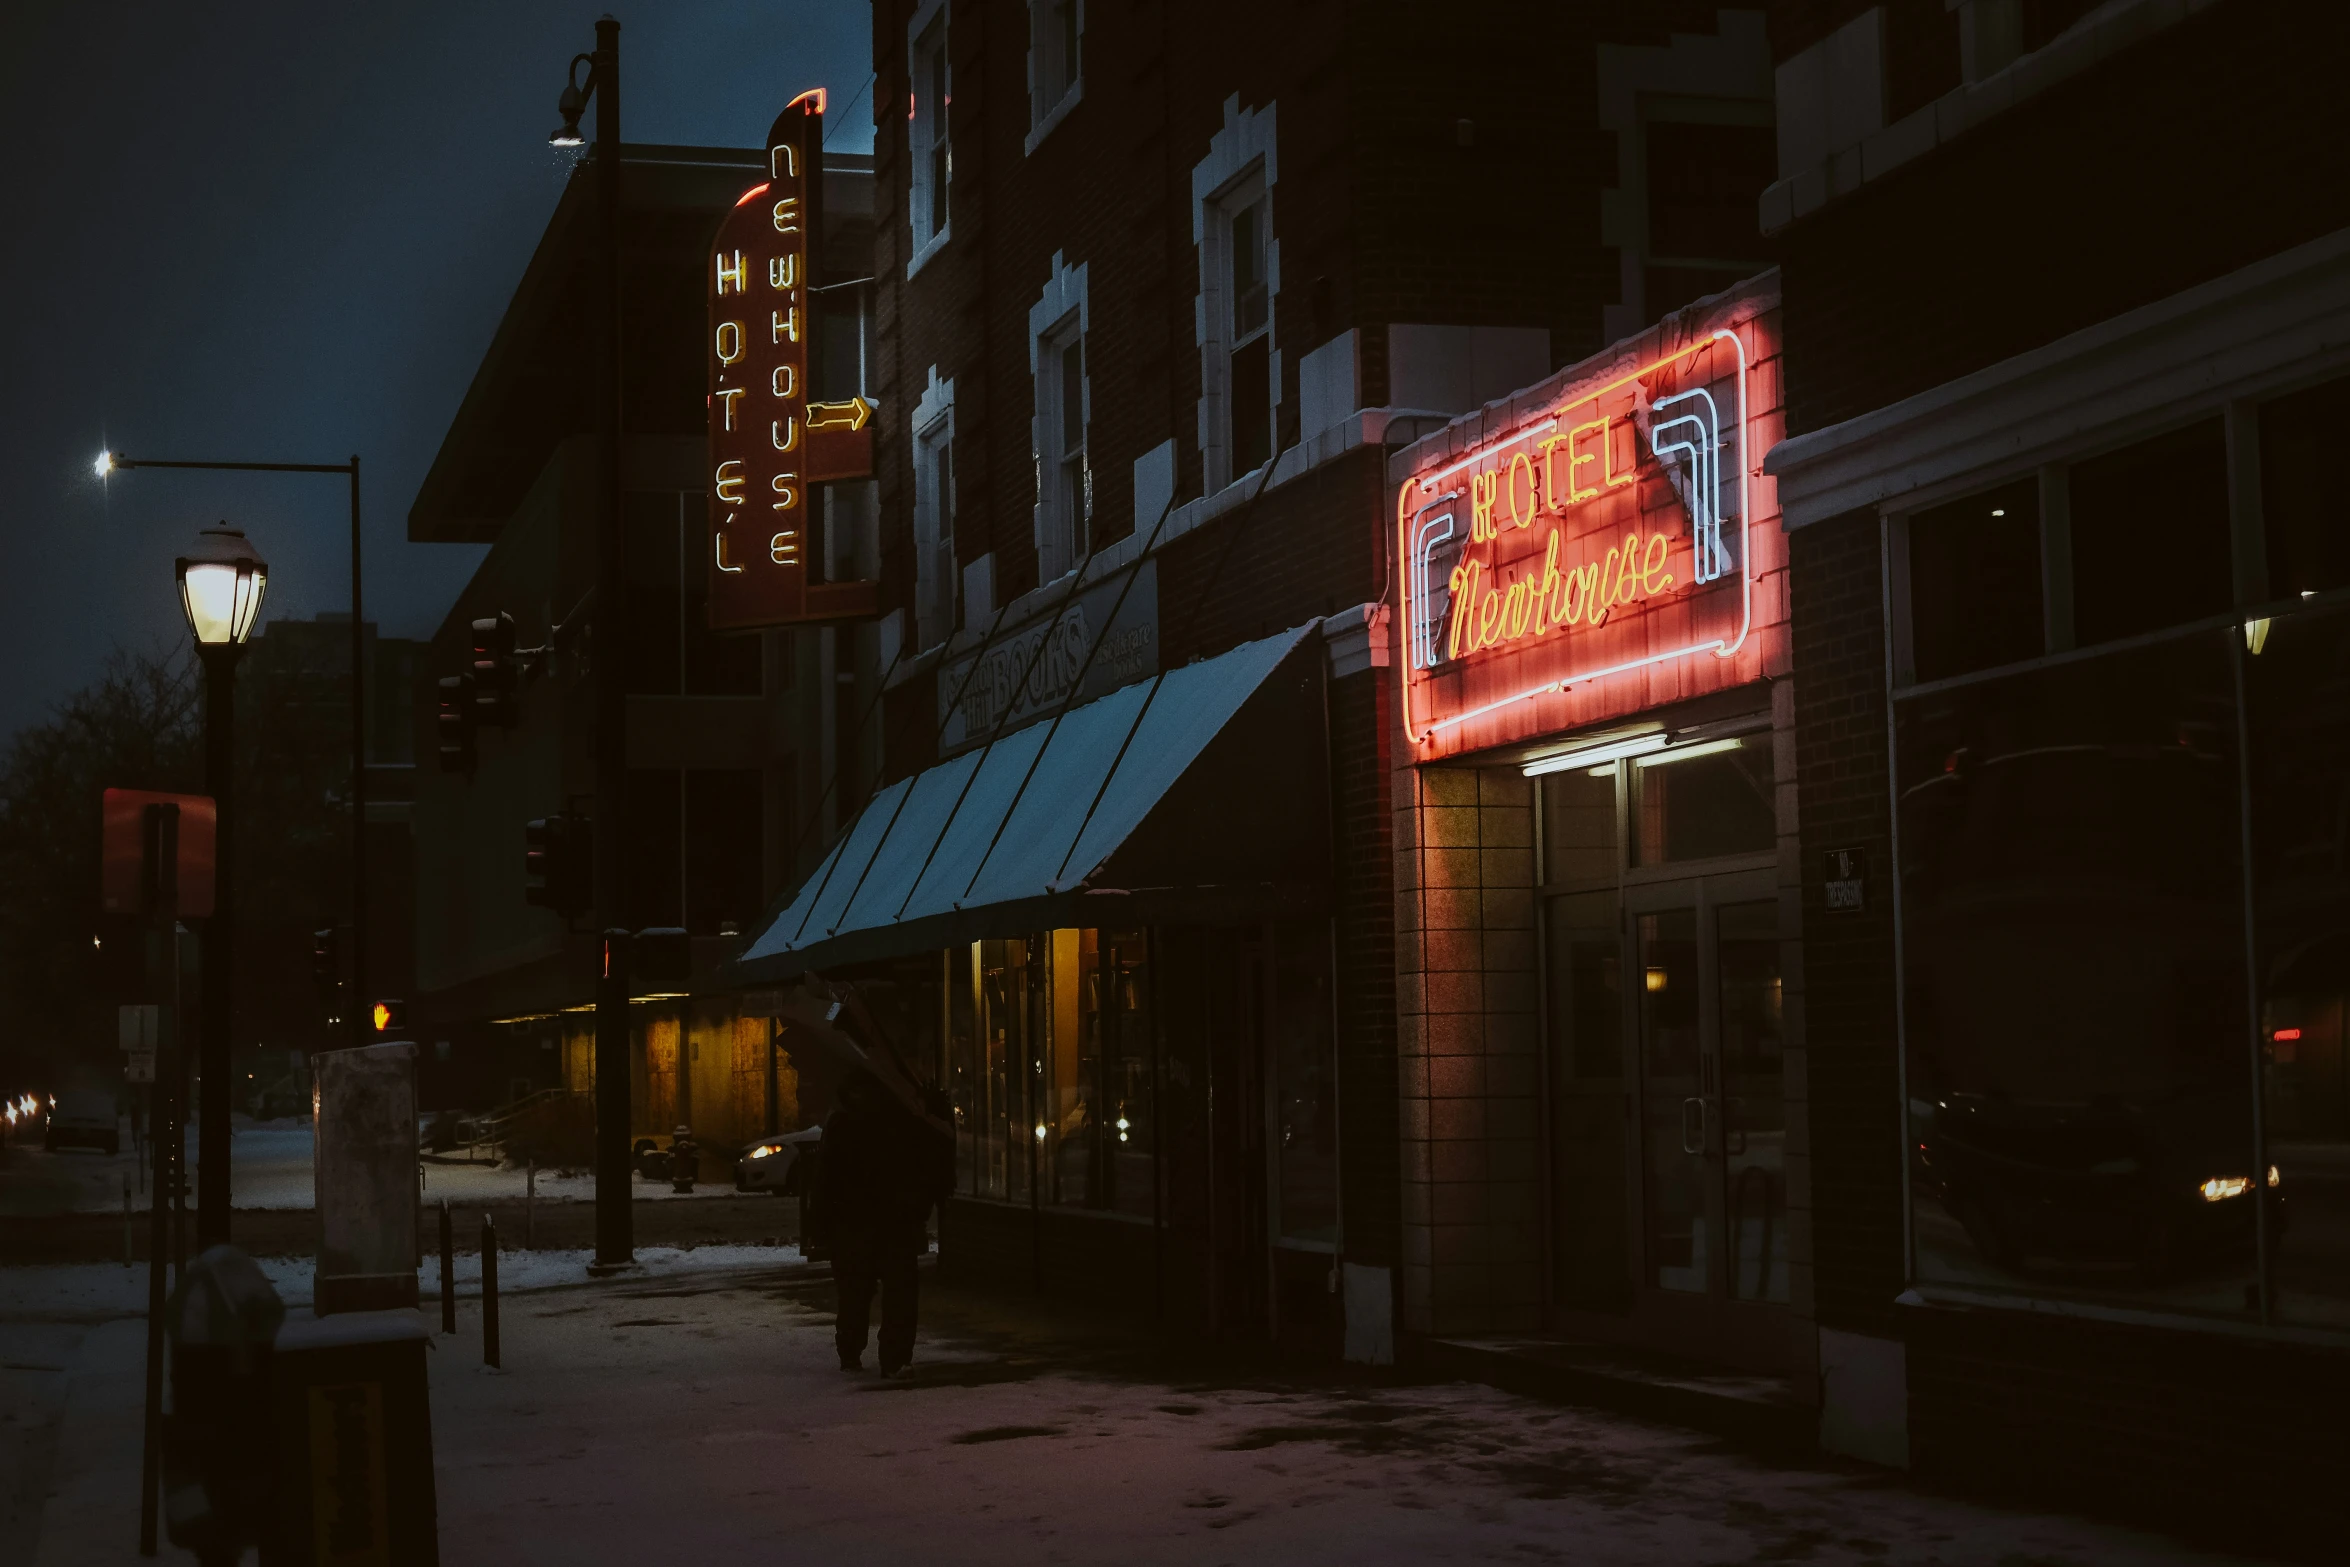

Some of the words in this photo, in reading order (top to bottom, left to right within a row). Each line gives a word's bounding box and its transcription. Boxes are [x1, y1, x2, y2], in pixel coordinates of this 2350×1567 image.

[715, 249, 747, 573] HOTEL
[1472, 415, 1634, 543] HOTEL
[1449, 529, 1674, 659] Newhouse
[966, 691, 993, 732] Hill
[992, 614, 1083, 718] BOOKS
